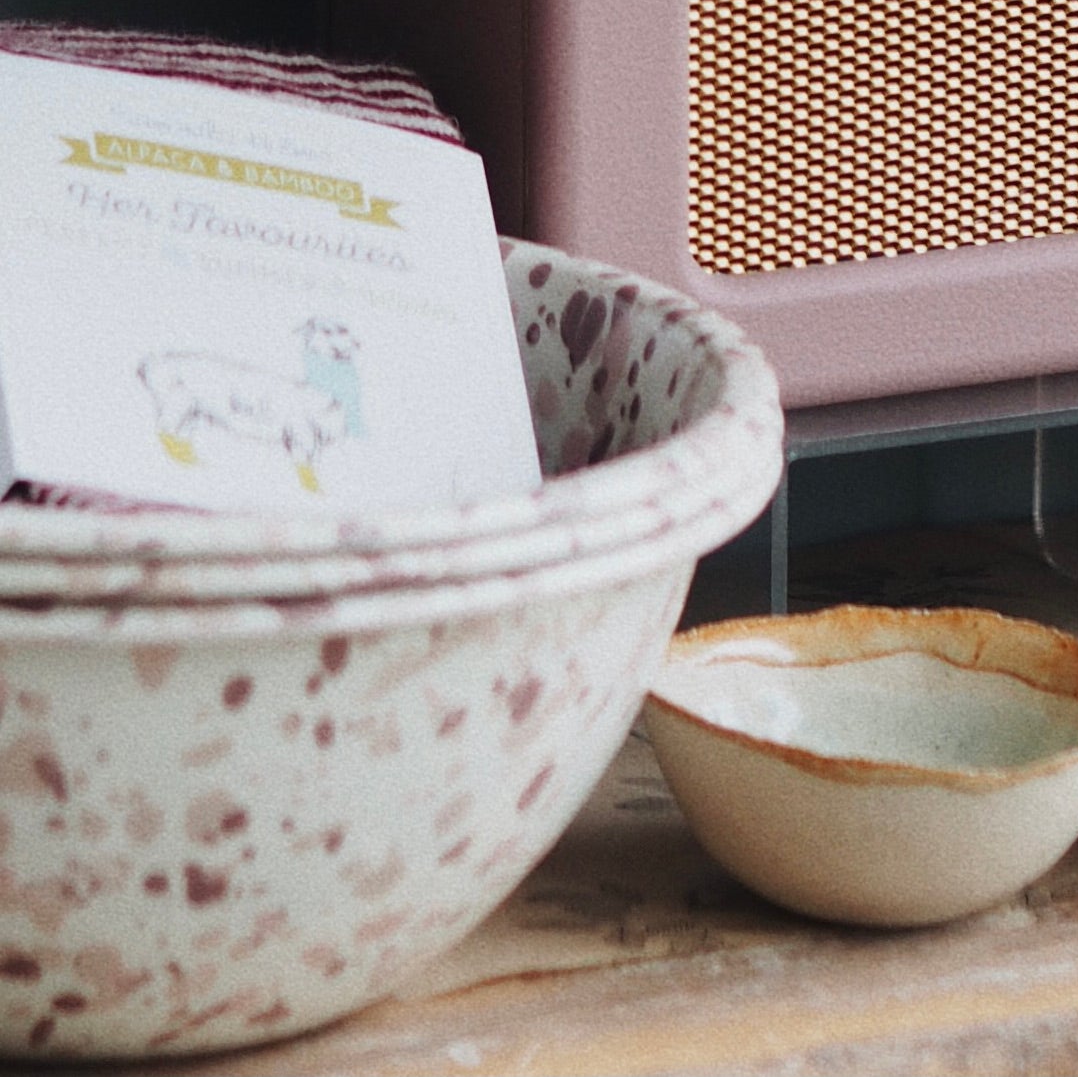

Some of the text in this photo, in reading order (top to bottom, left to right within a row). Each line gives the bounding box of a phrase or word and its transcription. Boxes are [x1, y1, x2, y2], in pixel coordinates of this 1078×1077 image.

[107, 140, 354, 203] ALPACA & BAMBOO
[66, 182, 155, 221] Her
[170, 200, 411, 272] Favourites
